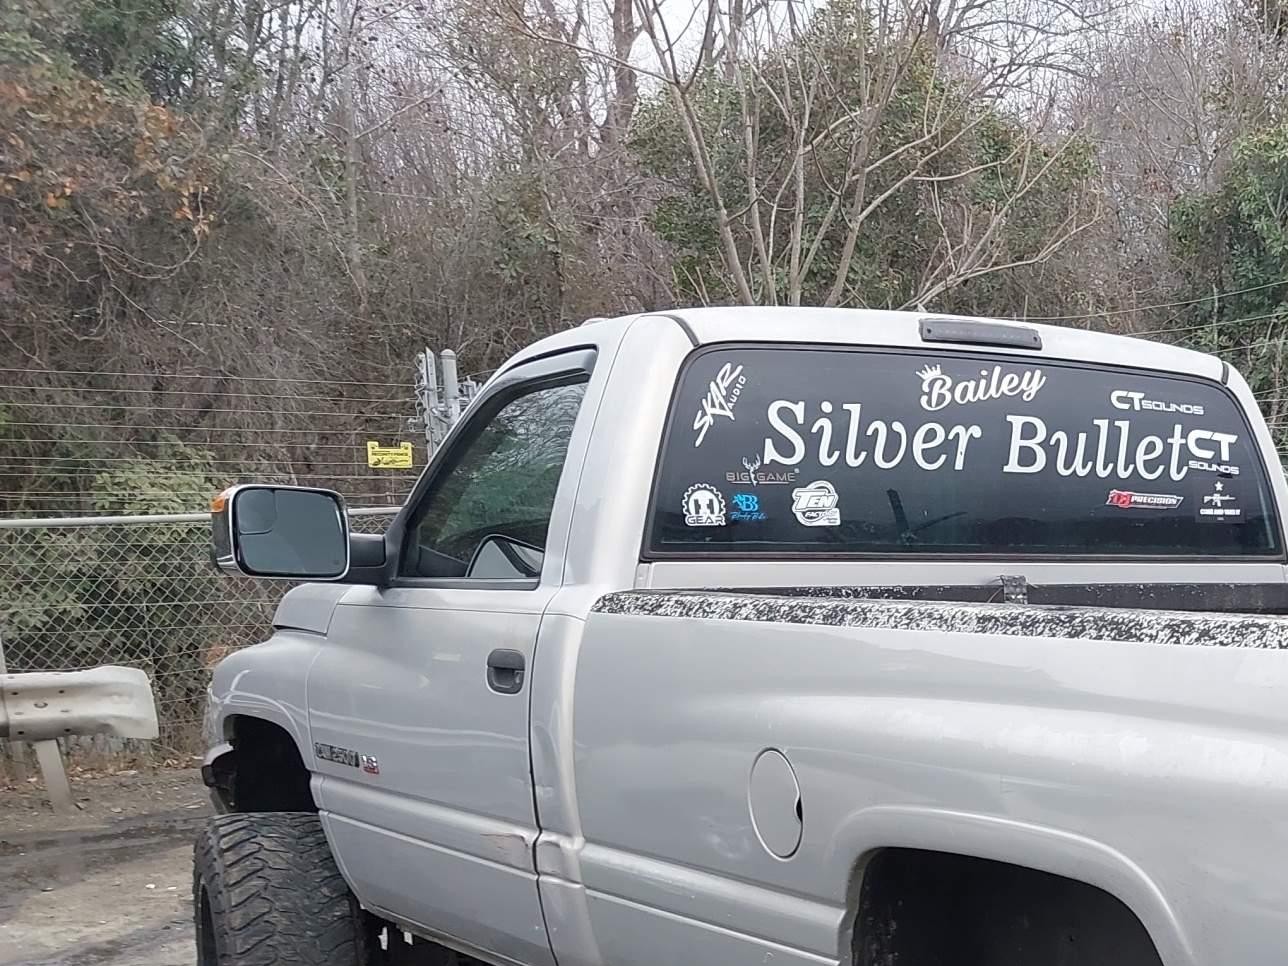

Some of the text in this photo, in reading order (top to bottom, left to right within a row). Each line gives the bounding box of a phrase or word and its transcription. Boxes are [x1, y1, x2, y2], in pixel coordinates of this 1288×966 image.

[727, 375, 746, 410] AUDIO
[920, 365, 1046, 411] Bailey
[692, 362, 744, 448] SKAR
[763, 400, 1189, 482] Silver Bullet
[1186, 429, 1238, 461] CT
[726, 472, 796, 482] BIG GAME
[1188, 460, 1240, 475] SOUNDS
[795, 489, 836, 511] TEN
[686, 514, 726, 526] GEAR
